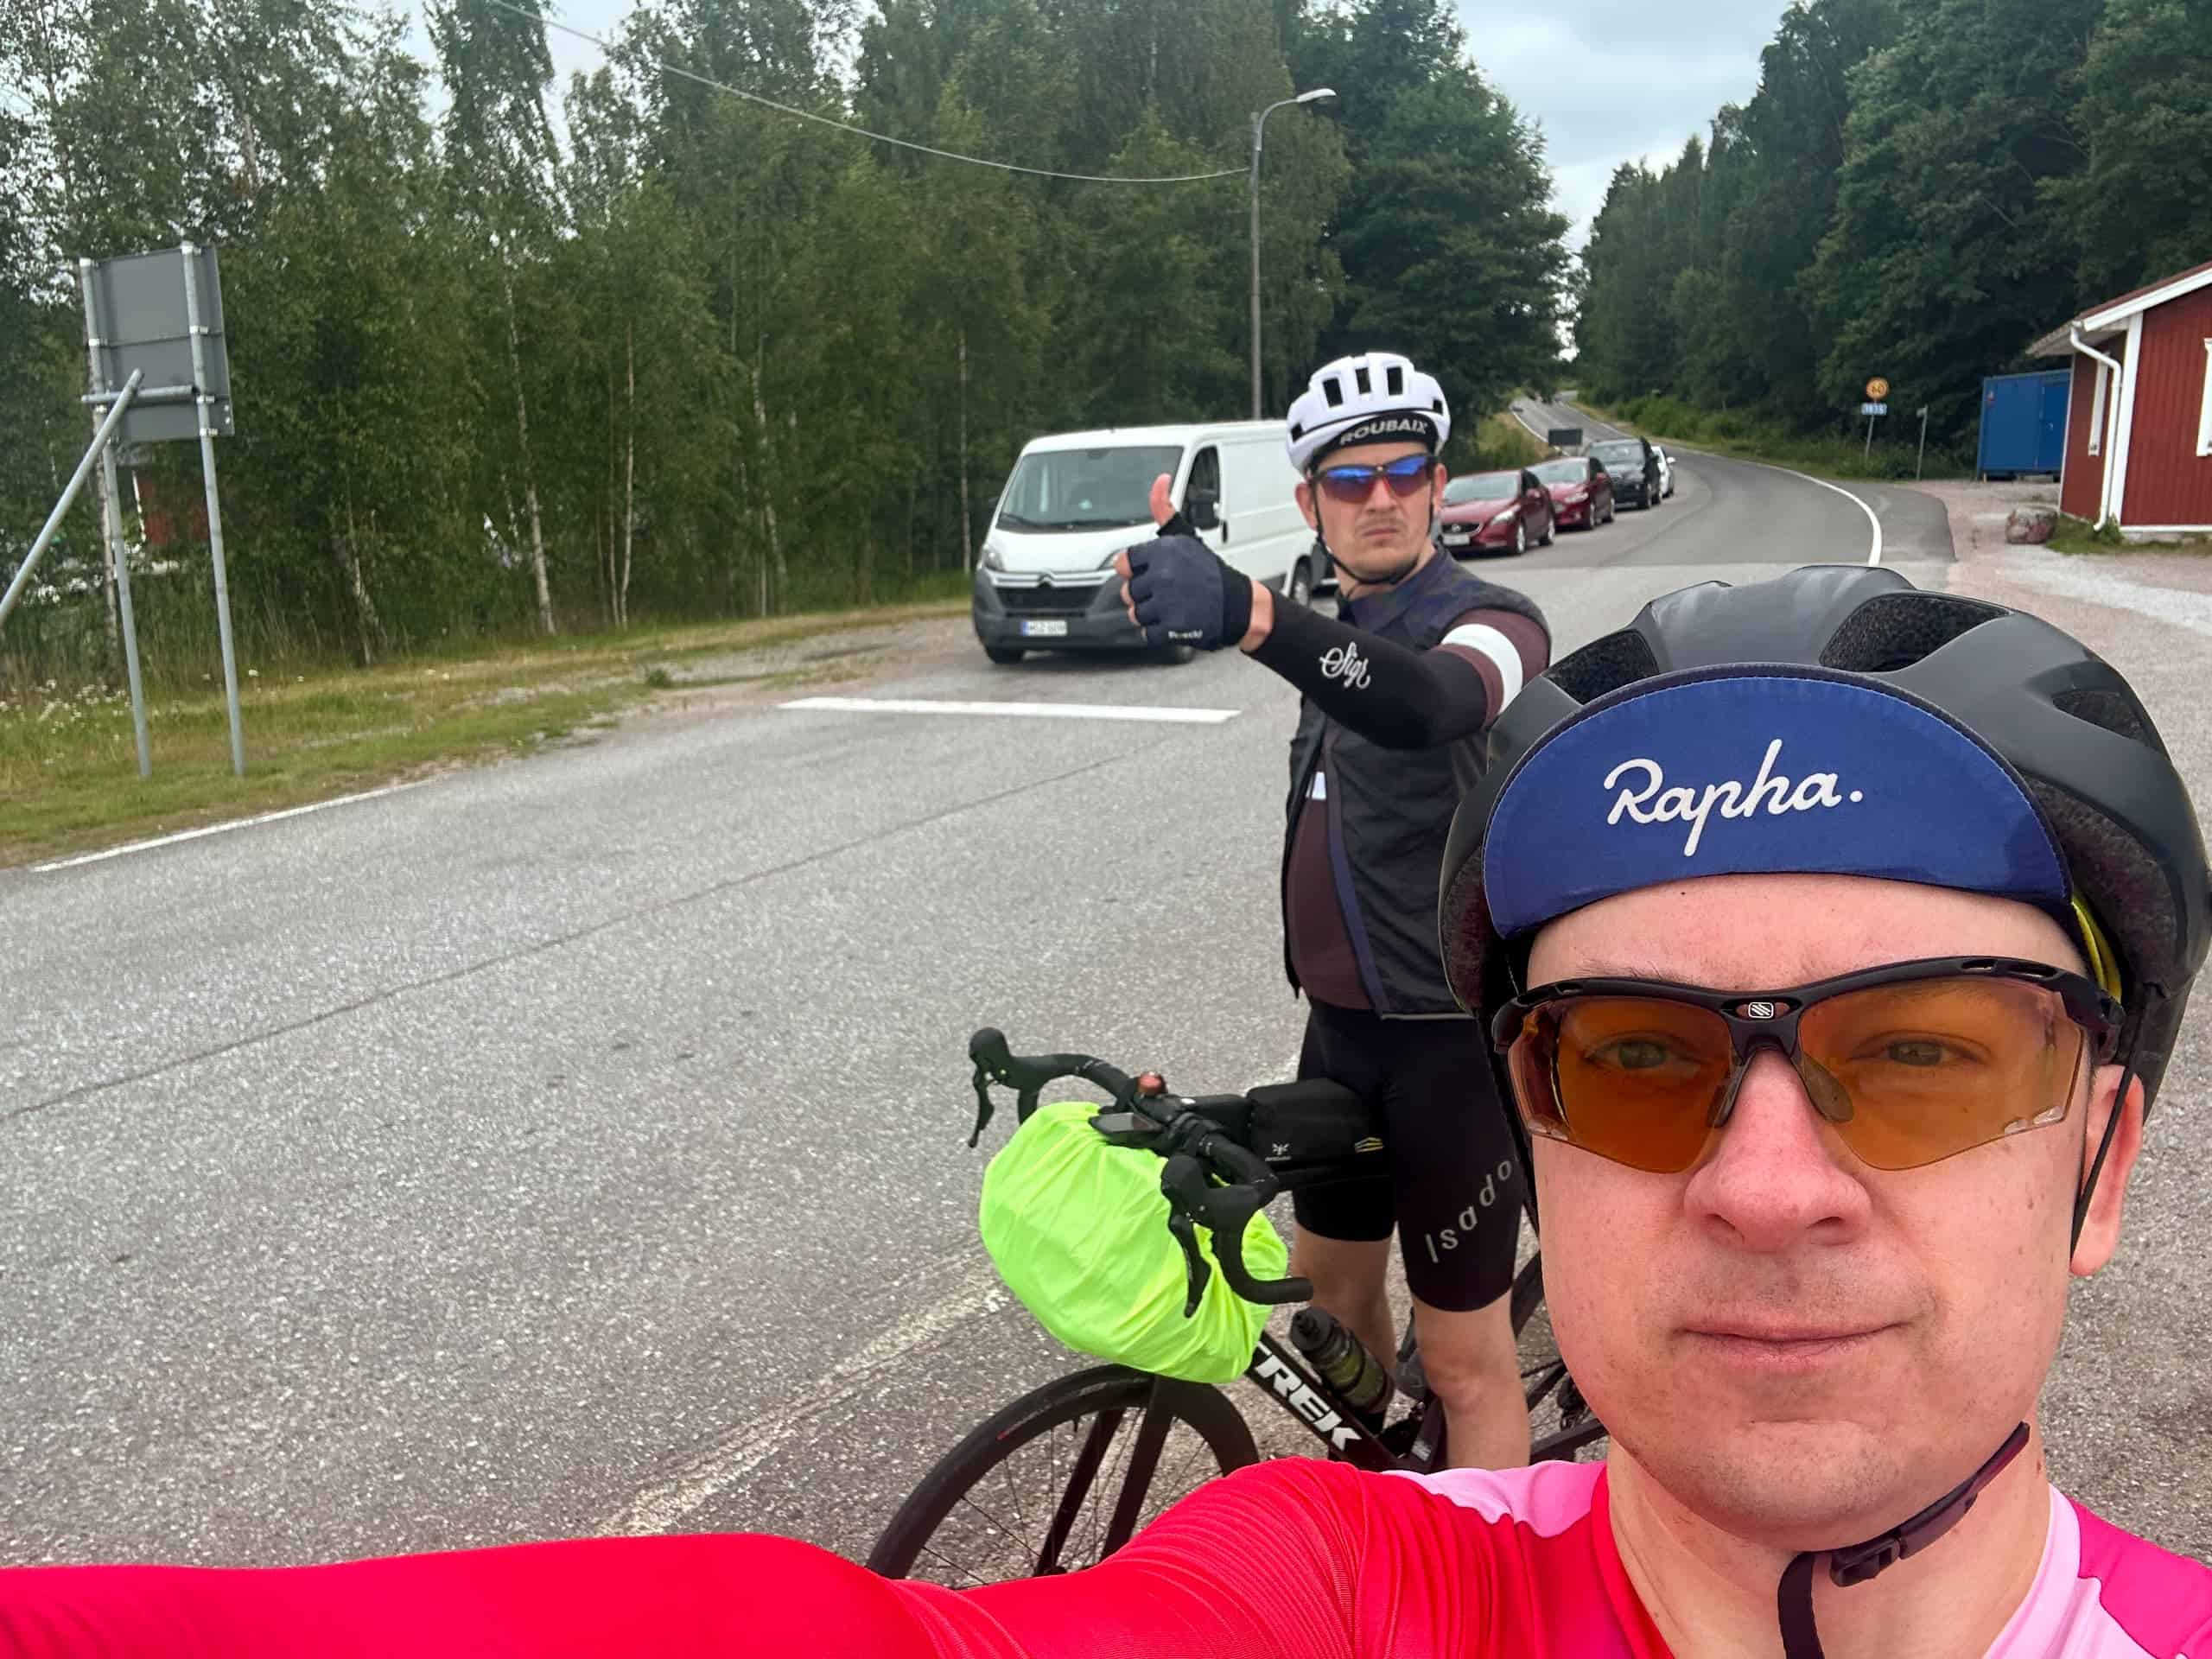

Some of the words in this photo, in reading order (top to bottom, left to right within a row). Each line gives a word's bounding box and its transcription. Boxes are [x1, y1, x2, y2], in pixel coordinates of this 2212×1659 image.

[1340, 418, 1428, 445] ROUBAIX
[1604, 739, 1863, 856] Rapha.
[1425, 1154, 1519, 1263] Isado
